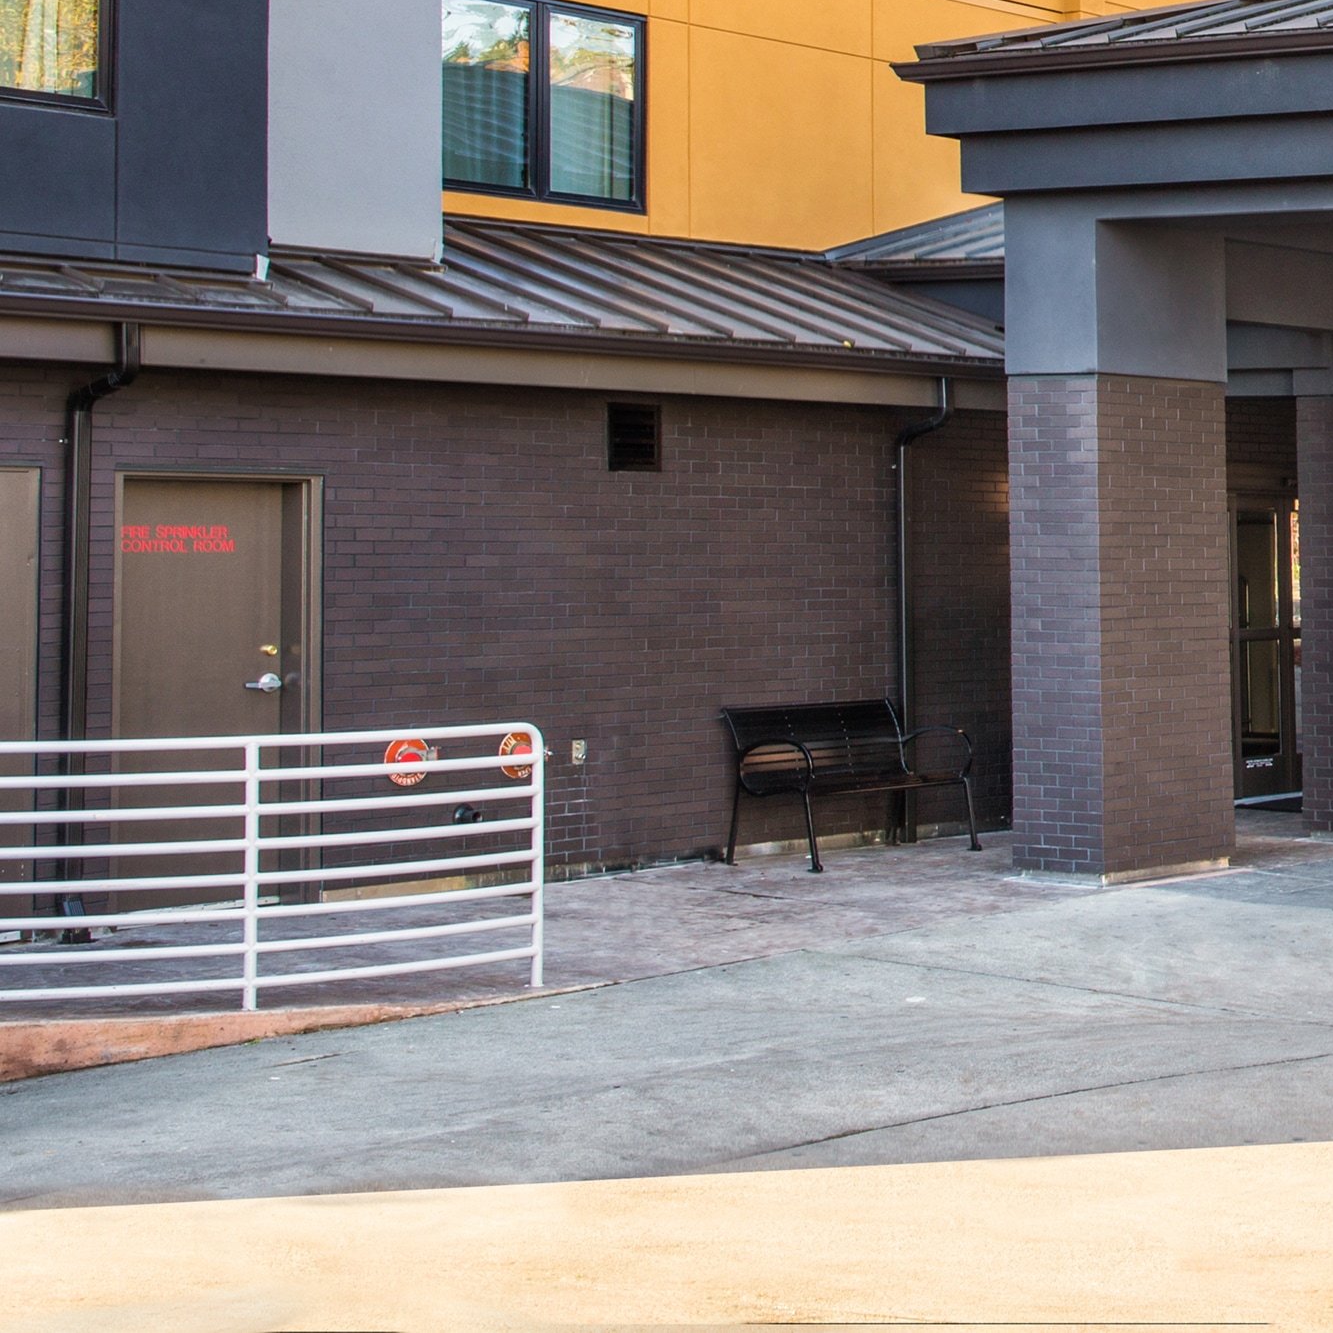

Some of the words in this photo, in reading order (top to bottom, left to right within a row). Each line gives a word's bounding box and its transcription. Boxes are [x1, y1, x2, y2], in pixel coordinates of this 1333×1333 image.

[121, 524, 150, 539] FIRE
[156, 524, 229, 539] SPRINKLER
[121, 539, 188, 553] CONTROL
[193, 539, 236, 553] ROOM
